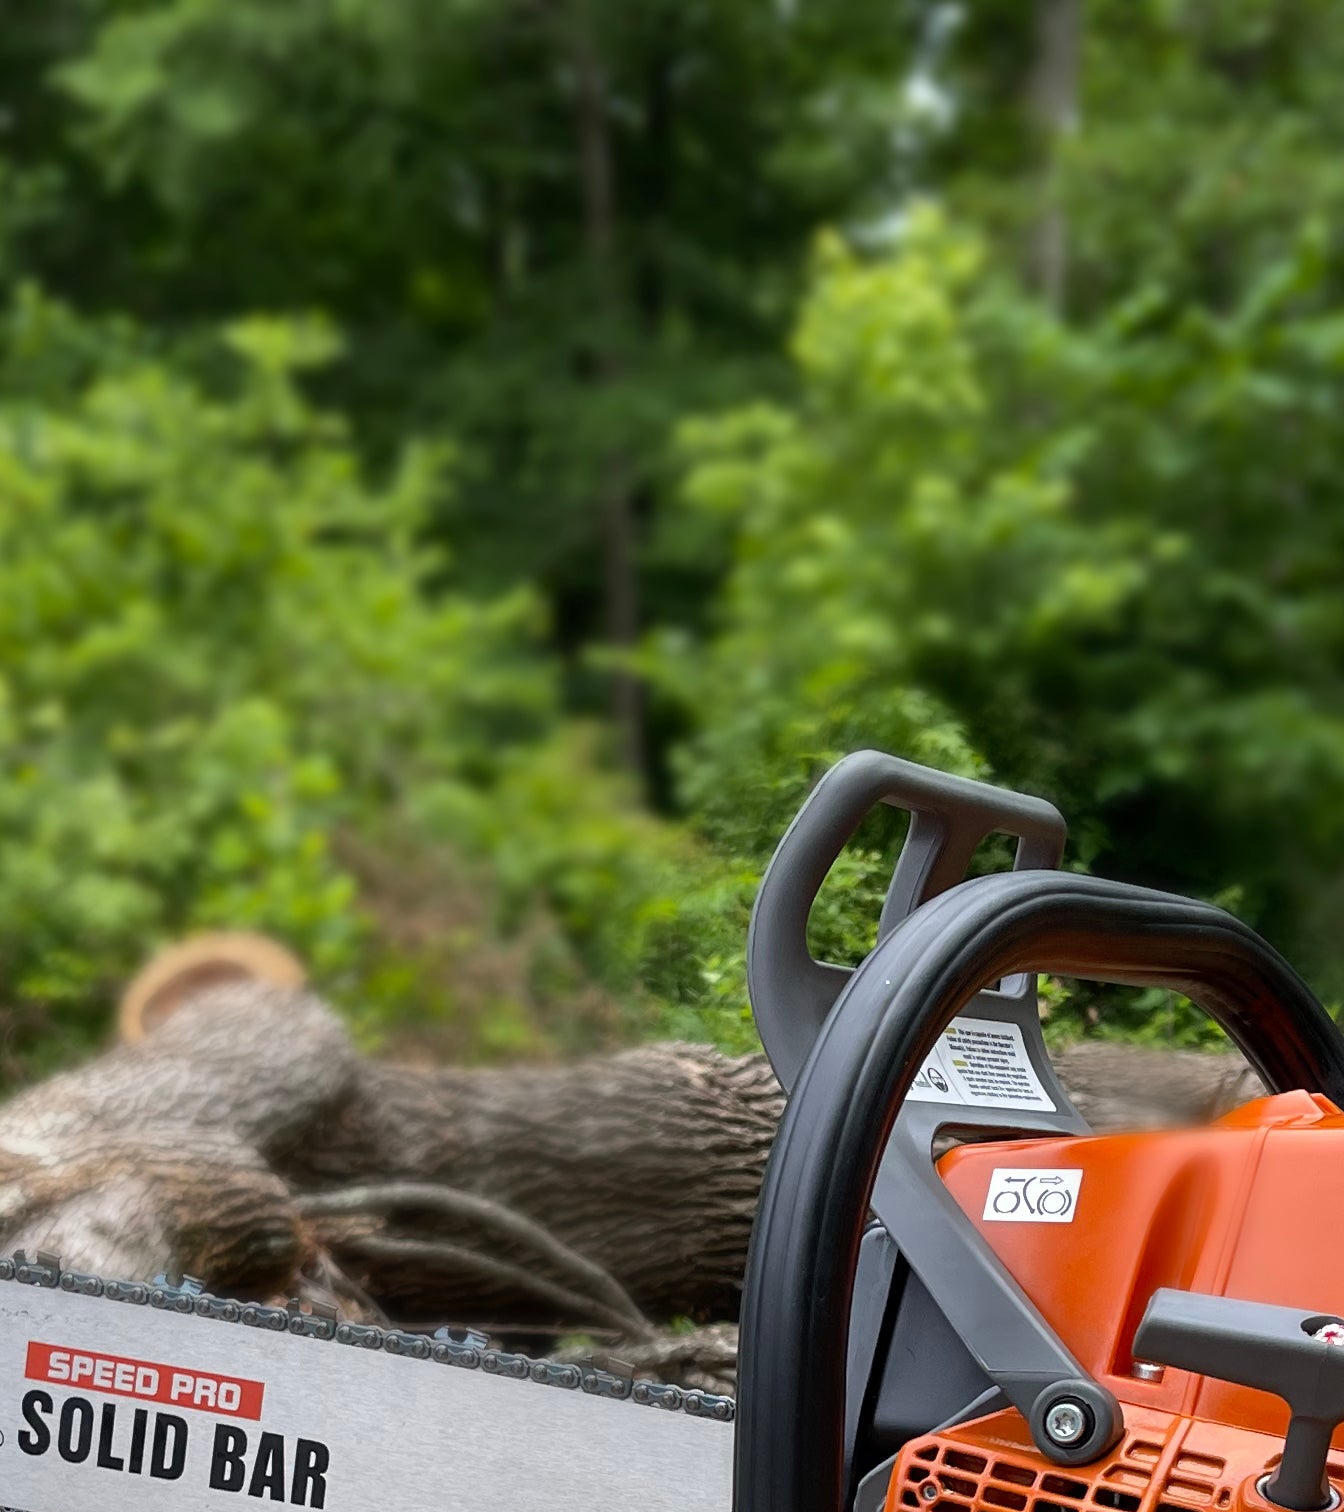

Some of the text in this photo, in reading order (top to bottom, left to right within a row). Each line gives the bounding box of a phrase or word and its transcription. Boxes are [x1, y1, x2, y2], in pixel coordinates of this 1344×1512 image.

[47, 1351, 242, 1412] SPEED PRO
[17, 1389, 331, 1510] SOLID BAR
